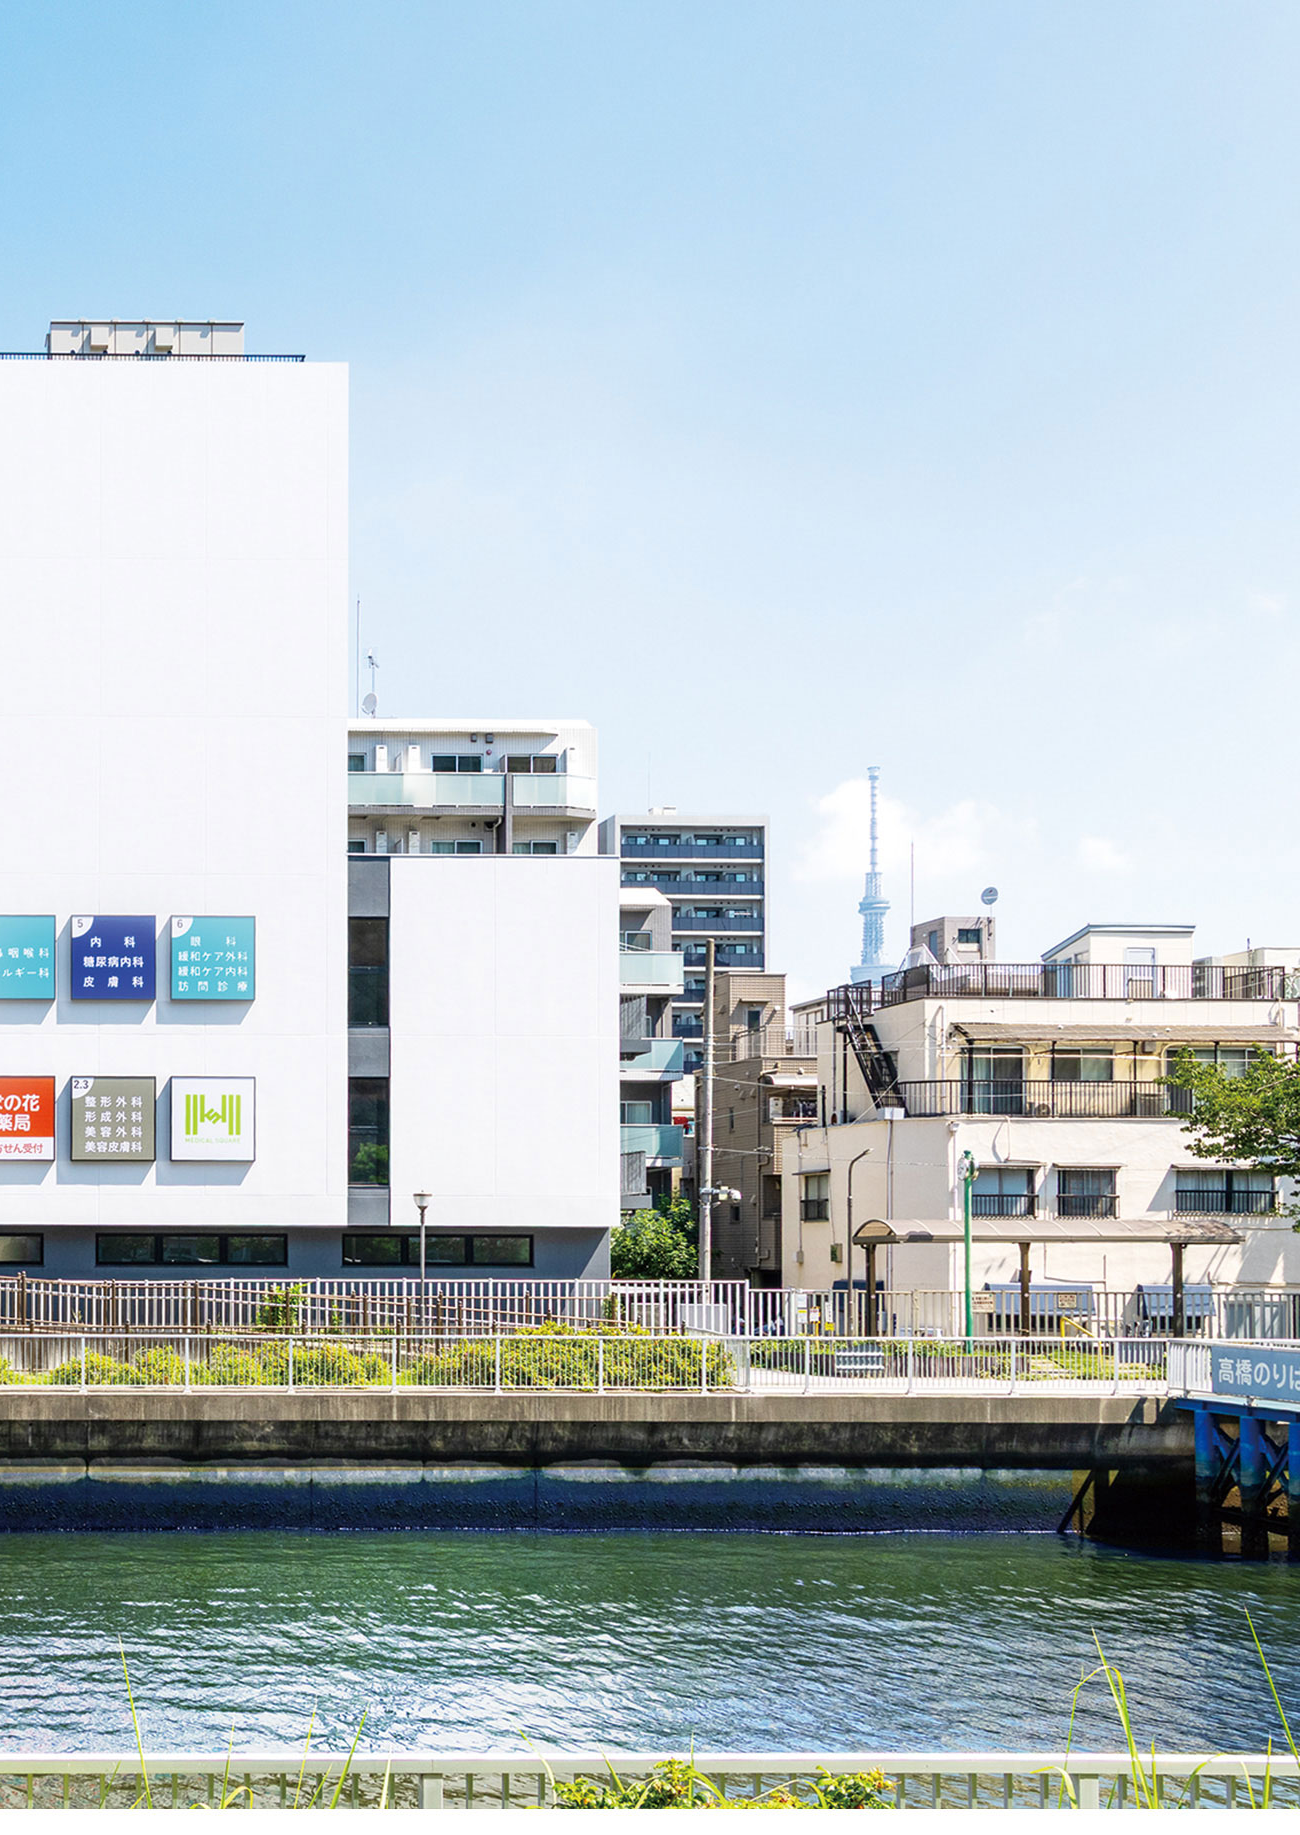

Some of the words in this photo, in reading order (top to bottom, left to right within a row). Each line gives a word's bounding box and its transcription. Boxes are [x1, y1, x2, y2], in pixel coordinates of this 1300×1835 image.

[77, 918, 84, 928] 5
[177, 919, 183, 928] 6
[90, 936, 135, 948] 内科
[190, 936, 236, 947] 眼科
[83, 956, 144, 968] 糖尿病内科
[178, 951, 248, 962] 緩和ケア外科
[178, 966, 248, 977] 緩和ケア内科
[83, 976, 144, 988] 皮膚科
[178, 981, 248, 992] 訪問診療
[74, 1080, 89, 1089] 2.3
[84, 1096, 143, 1108] 整形外科
[84, 1111, 143, 1122] 形成外科
[84, 1126, 143, 1138] 美容外科
[84, 1141, 143, 1153] 美容皮膚科
[1218, 1357, 1300, 1392] 高橋のりは
